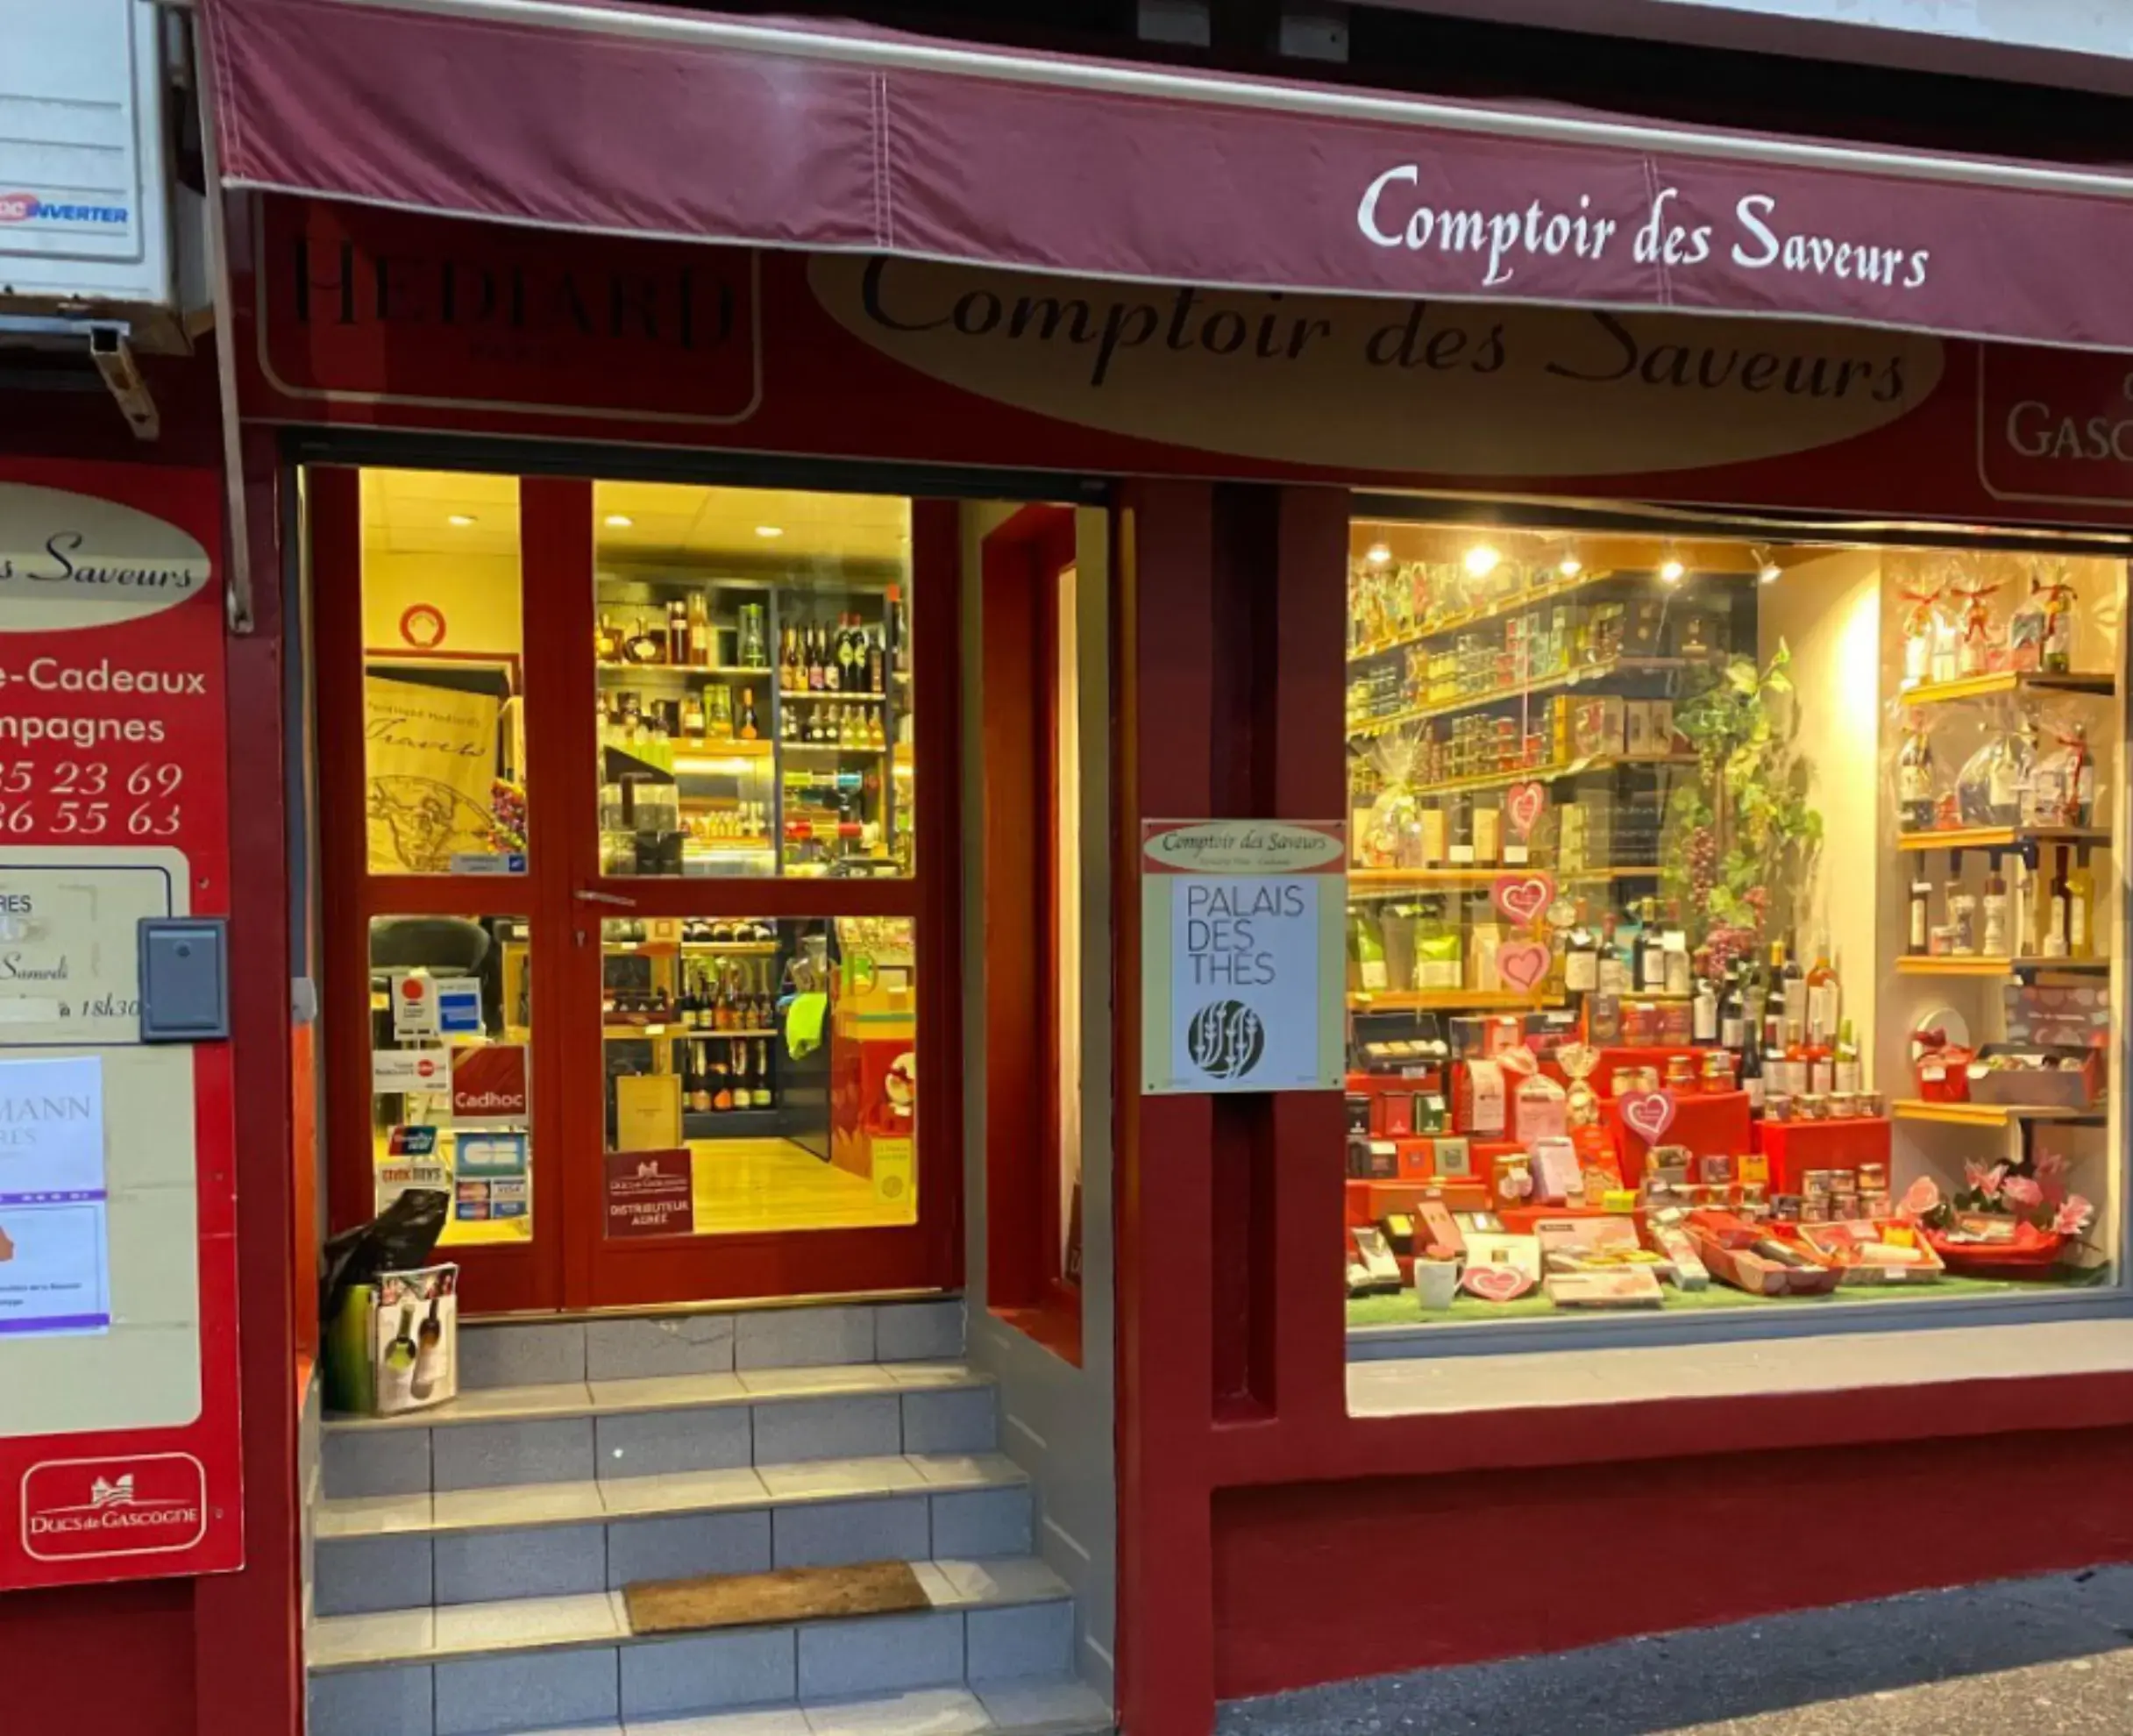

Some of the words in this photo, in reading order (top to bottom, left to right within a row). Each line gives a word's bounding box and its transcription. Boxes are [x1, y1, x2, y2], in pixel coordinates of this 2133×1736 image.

[1356, 164, 1616, 287] Comptoir
[1632, 189, 1712, 264] des
[1731, 195, 1930, 288] Saveurs
[861, 254, 1331, 387] Comptoir
[1363, 302, 1506, 374] des
[27, 530, 192, 588] Saveurs
[50, 761, 109, 794] 23
[127, 763, 183, 797] 69
[50, 802, 110, 833] 55
[127, 803, 181, 834] 63
[1188, 885, 1305, 917] PALAIS
[1188, 919, 1255, 952] DES
[455, 1092, 523, 1108] Cadhoc
